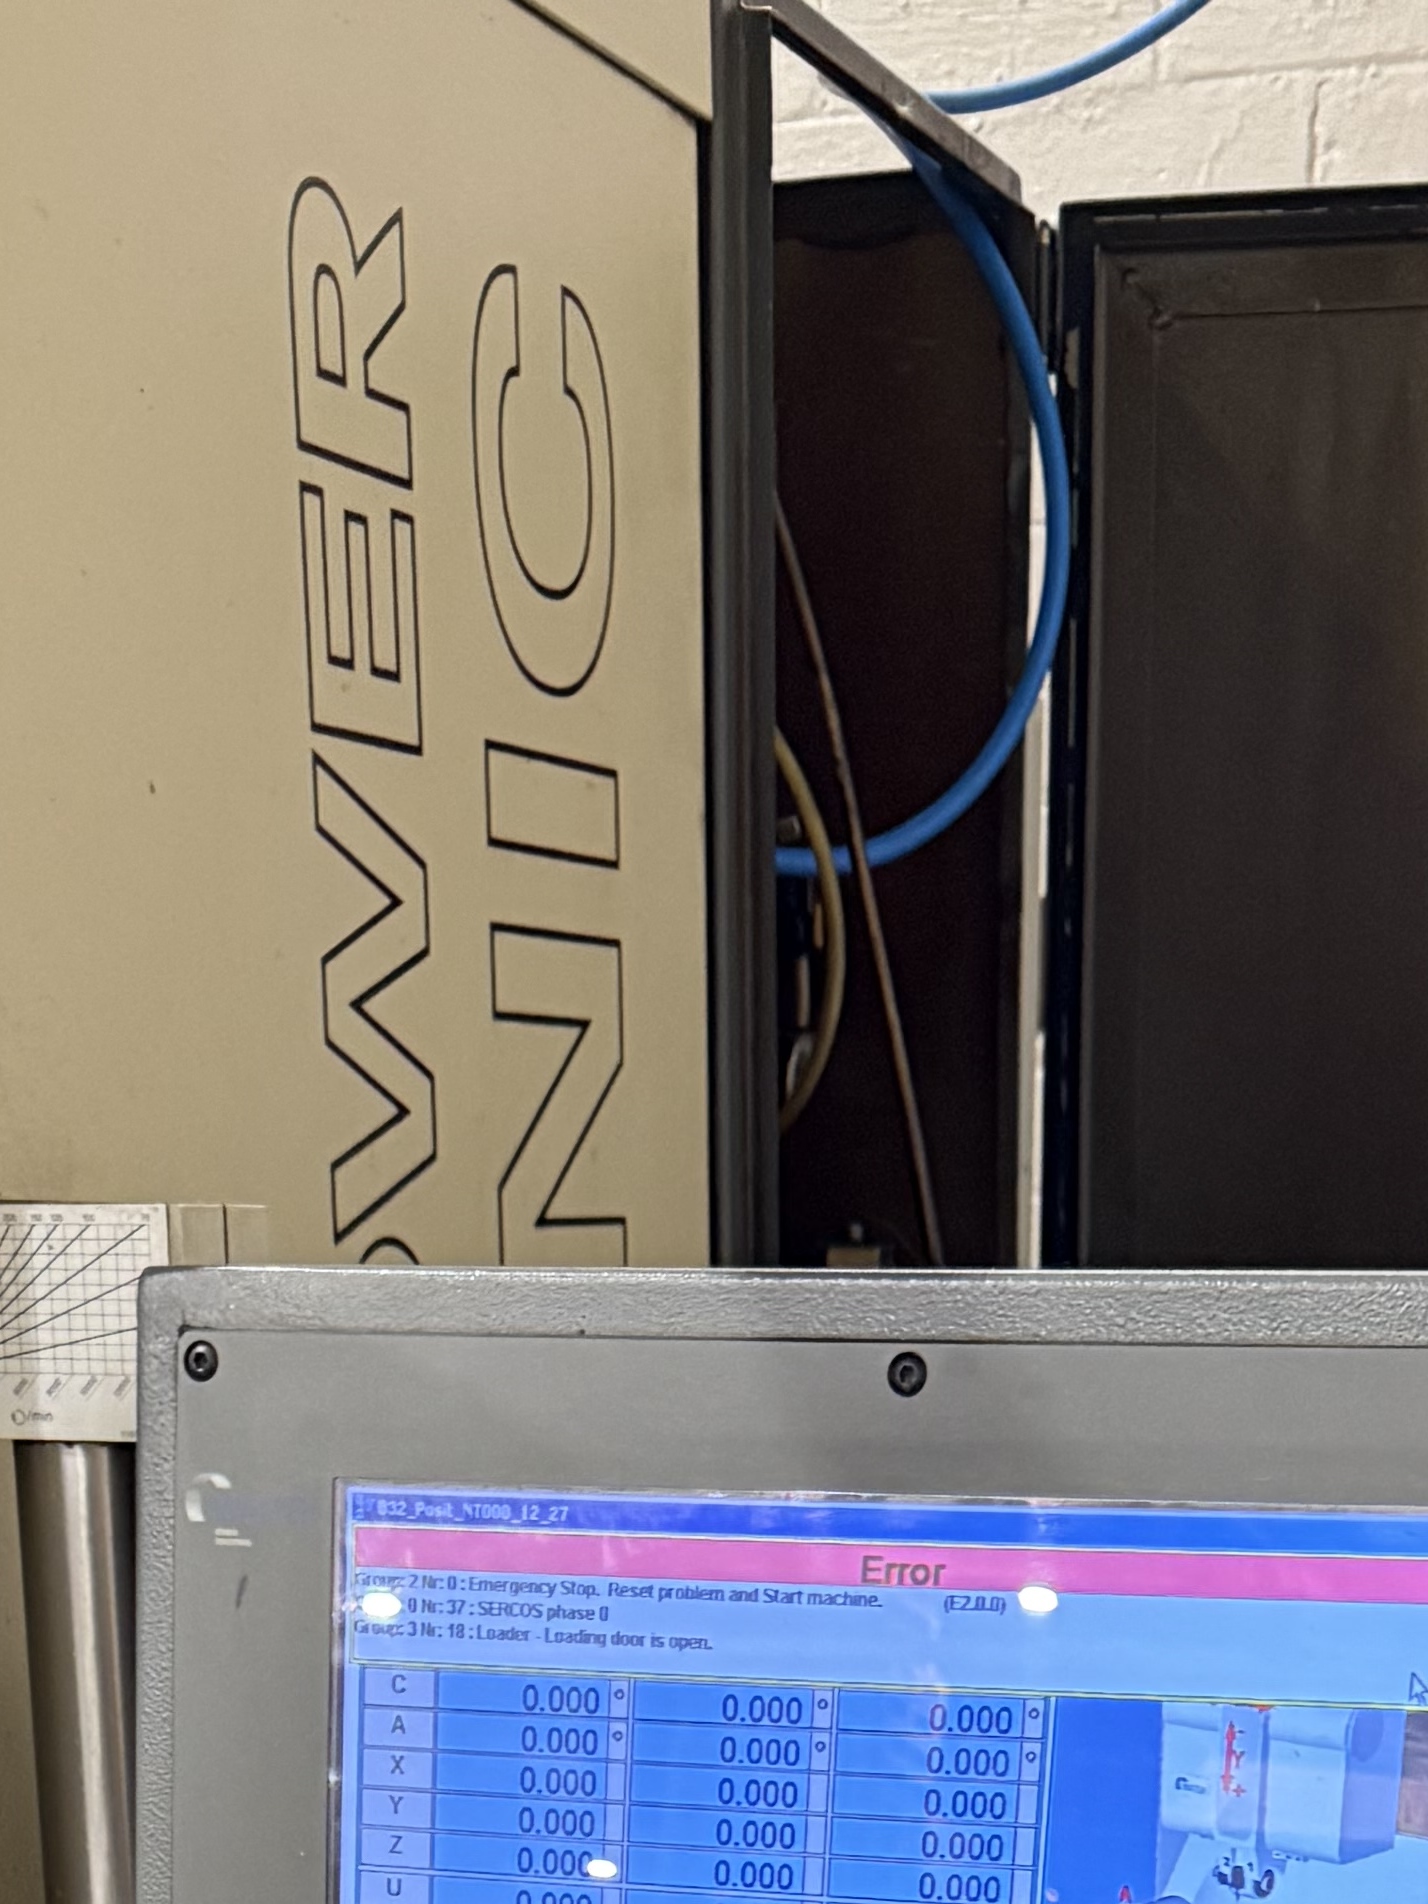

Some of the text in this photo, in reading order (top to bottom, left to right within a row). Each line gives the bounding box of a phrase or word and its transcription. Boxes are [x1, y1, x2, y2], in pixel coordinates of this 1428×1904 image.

[469, 1577, 557, 1597] Emergency
[608, 1582, 655, 1600] Reset
[658, 1585, 725, 1602] problem
[728, 1587, 759, 1603] and
[764, 1588, 803, 1605] Start
[861, 1555, 946, 1588] Error
[478, 1601, 596, 1622] SERCOS phase
[477, 1624, 646, 1649] Loader Loading door
[391, 1675, 1013, 1735] C 0.000 0.000 0.000
[391, 1716, 1010, 1778] A 0.000 0.000 0.000
[390, 1755, 1007, 1820] X 0.000 0.000 0.000
[388, 1796, 1004, 1862] Y 0.000 0.000 0.000
[386, 1878, 403, 1897] U
[389, 1836, 1001, 1904] Z 0.000 0.000
